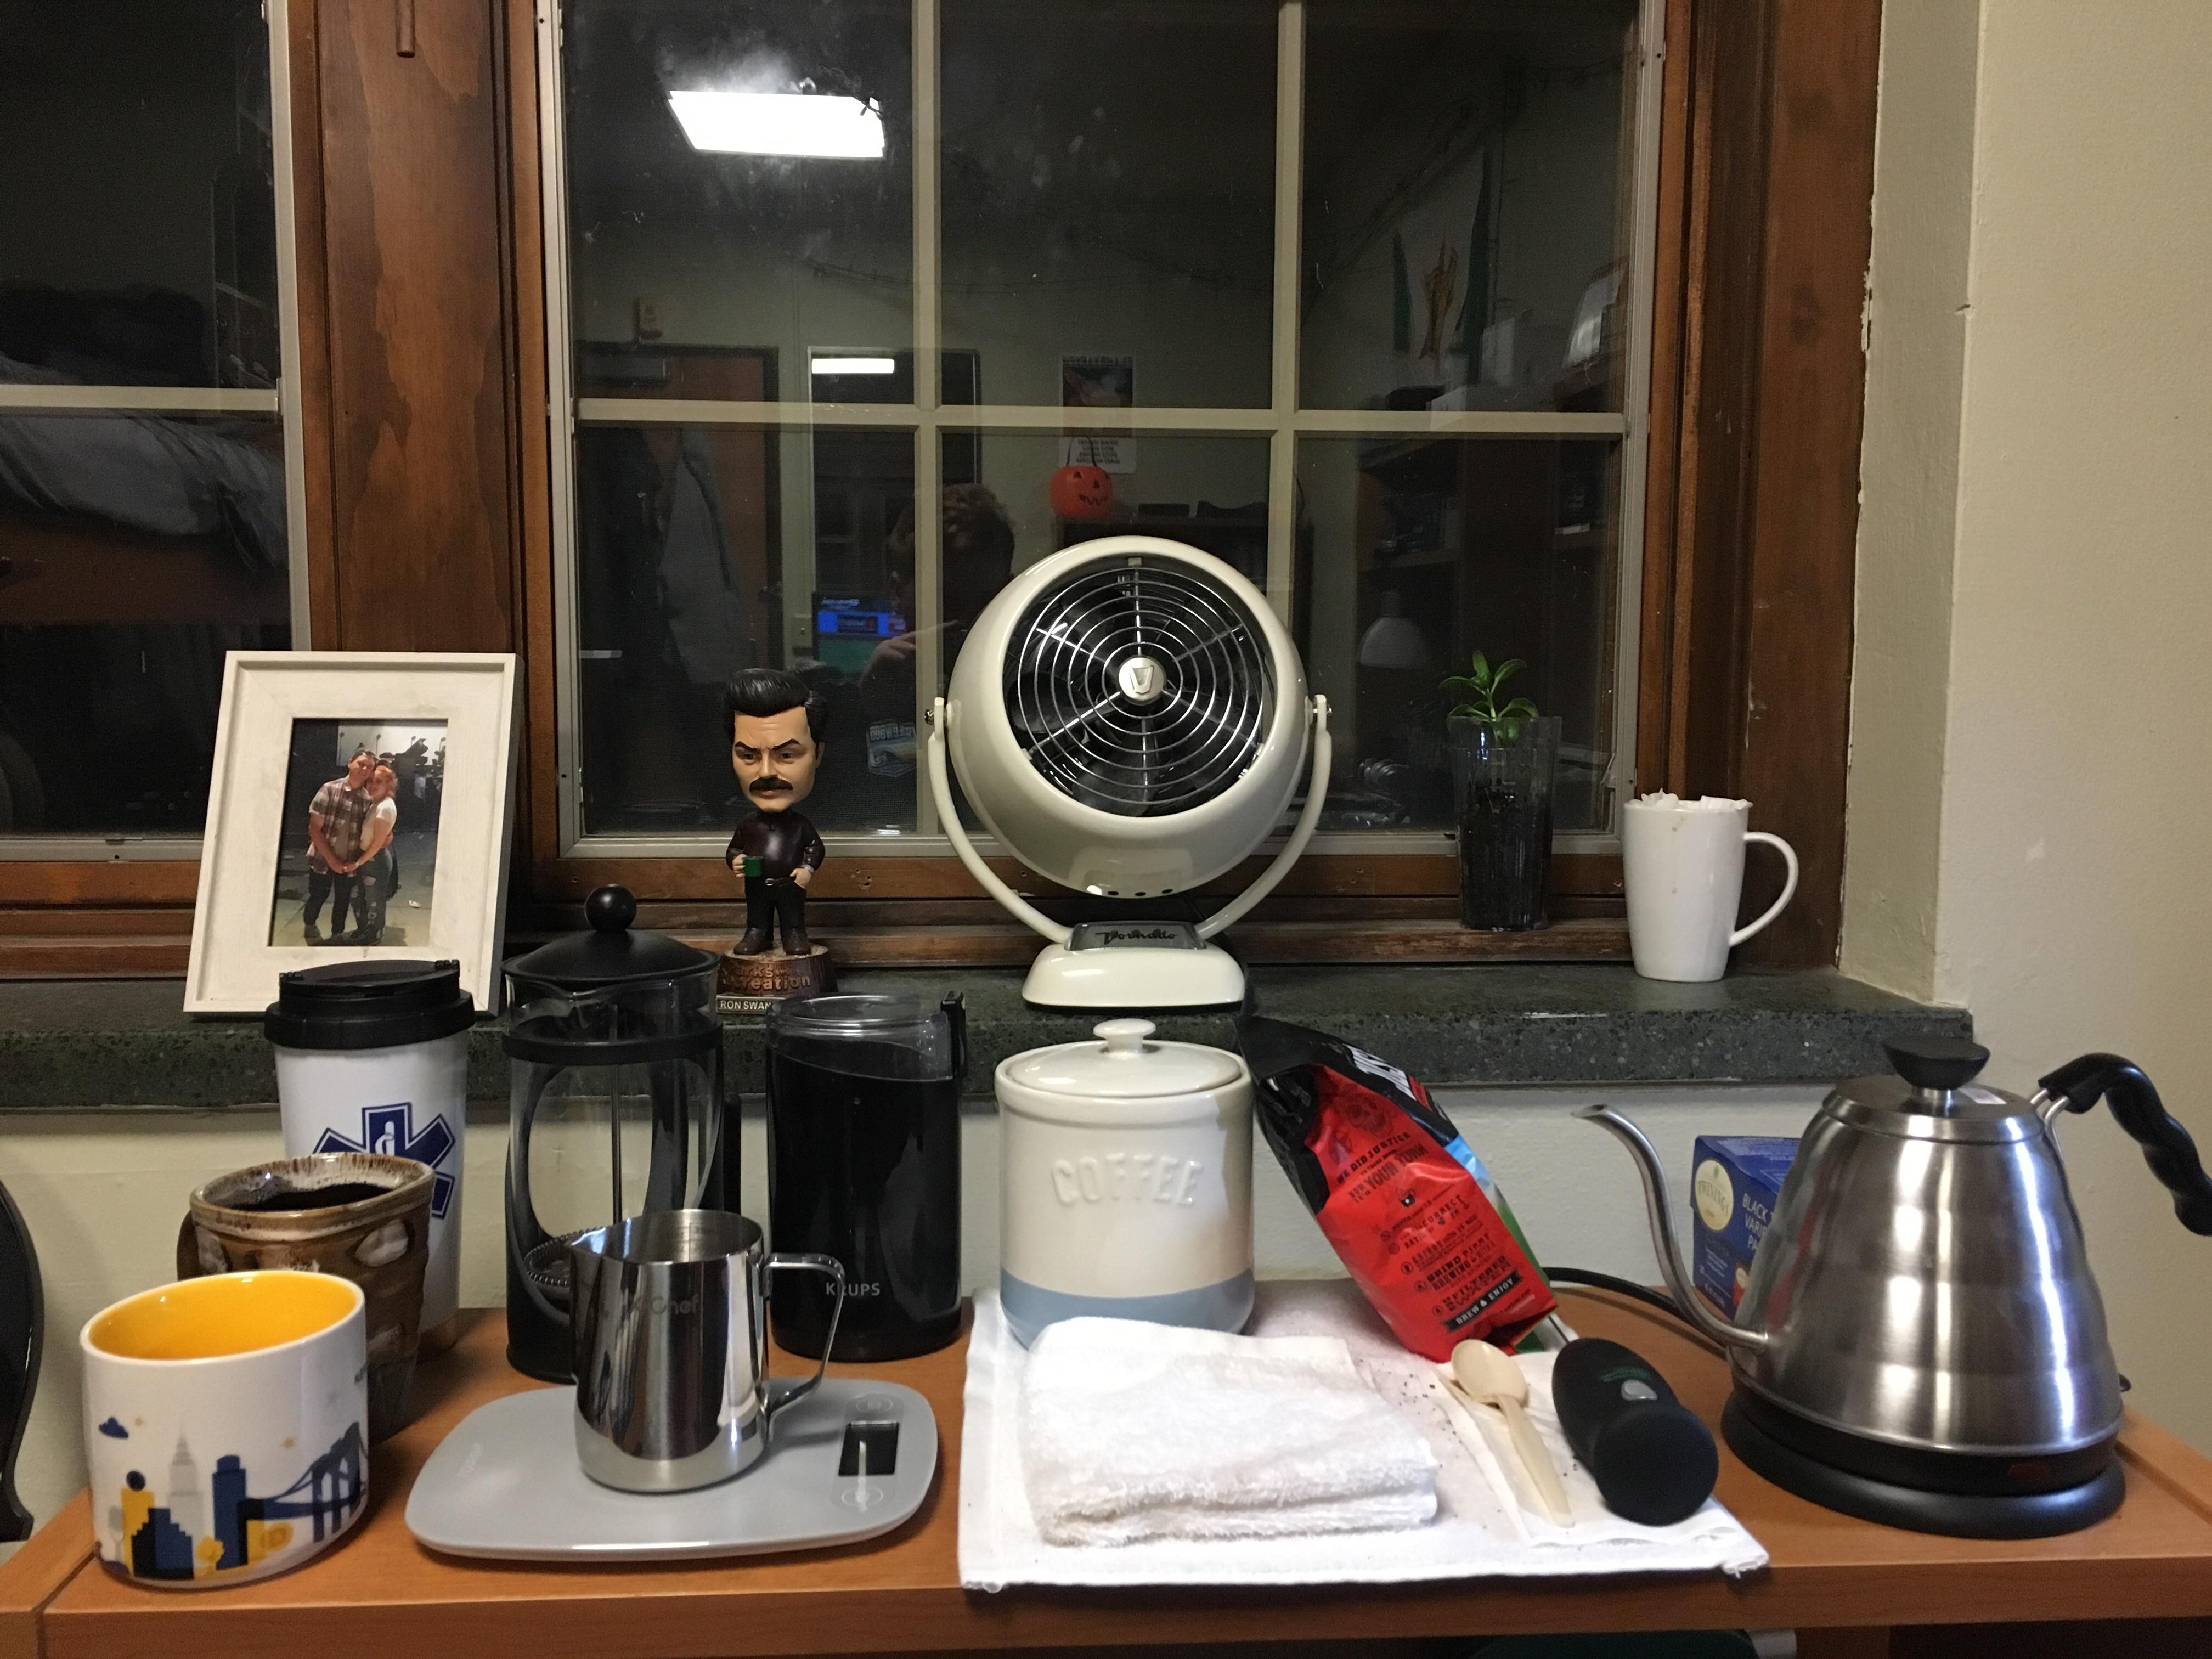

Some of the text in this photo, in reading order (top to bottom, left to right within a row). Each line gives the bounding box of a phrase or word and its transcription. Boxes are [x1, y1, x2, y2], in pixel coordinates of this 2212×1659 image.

[720, 1000, 741, 1009] RON
[1350, 1155, 1368, 1171] DID
[1368, 1132, 1411, 1158] JUSTICE
[1051, 1152, 1204, 1206] COFFEE
[1364, 1161, 1399, 1190] YOUR
[1421, 1194, 1469, 1227] CORRECT
[1742, 1193, 1768, 1223] BLACK
[1455, 1304, 1480, 1325] BREW
[1488, 1278, 1514, 1301] ENJOY
